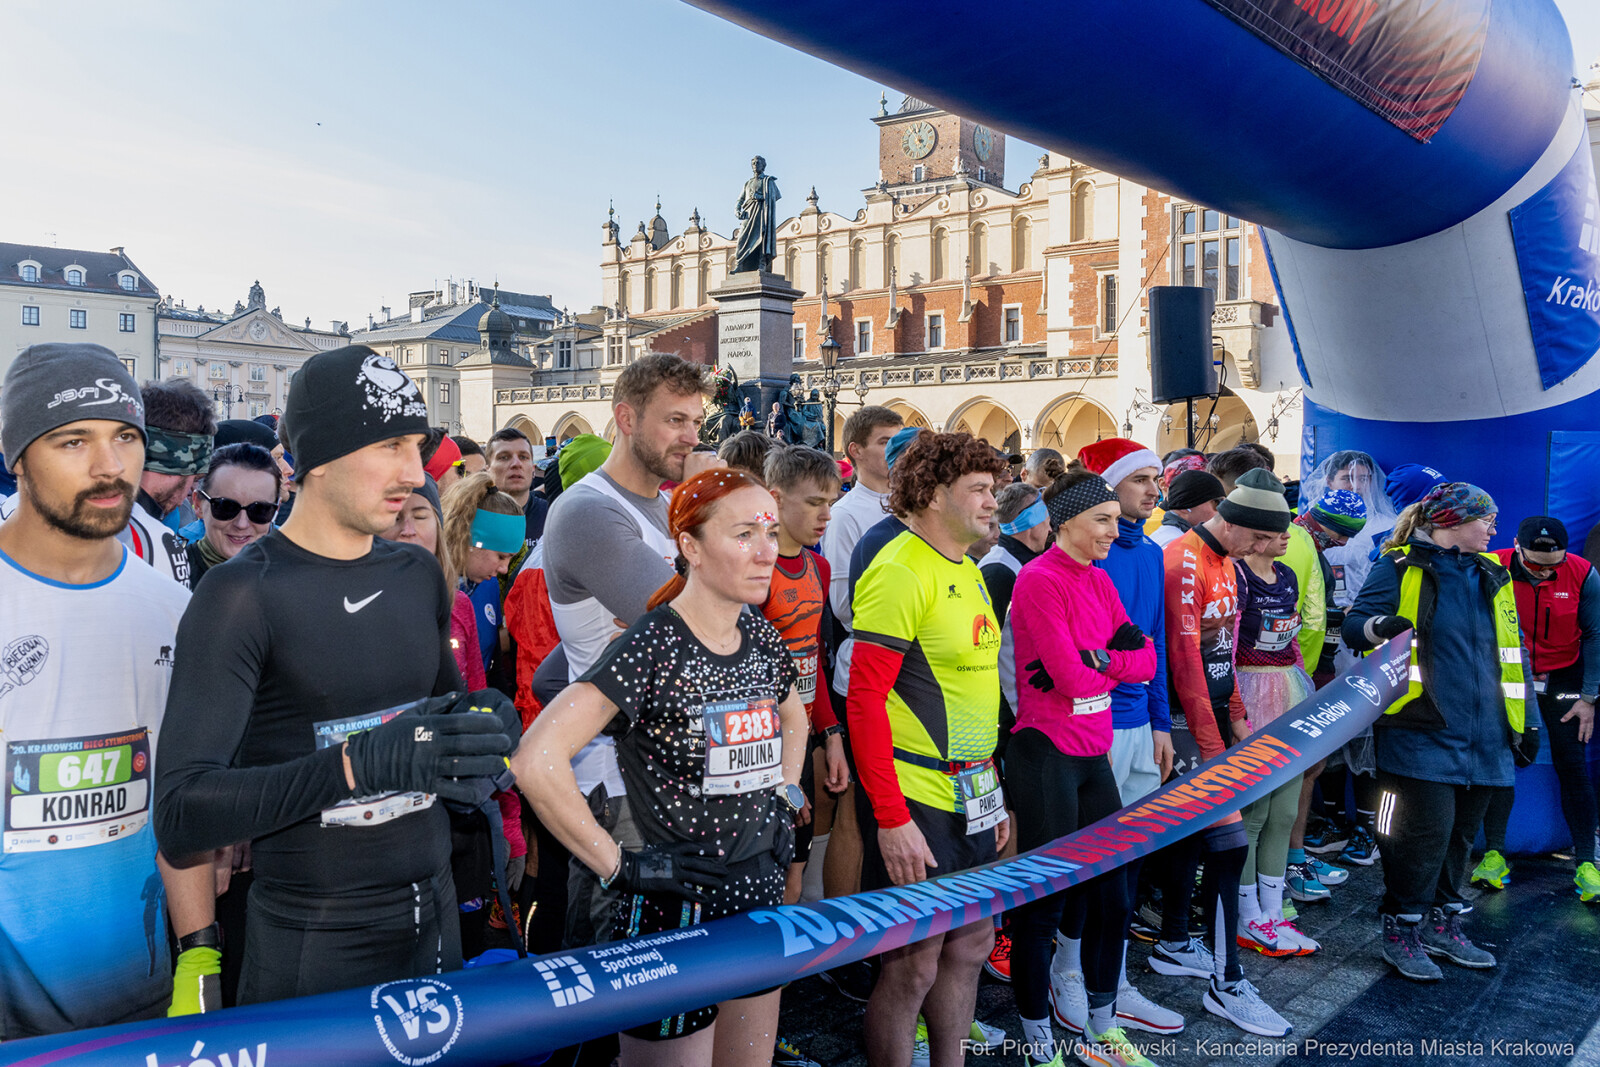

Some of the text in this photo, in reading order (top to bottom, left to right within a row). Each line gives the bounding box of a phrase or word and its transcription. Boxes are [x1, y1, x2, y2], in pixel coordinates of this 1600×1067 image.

[725, 323, 754, 331] ADAMOWI
[1181, 548, 1197, 605] KLIF
[7, 638, 40, 669] BIEGOWA
[17, 650, 44, 675] KUŹNIA
[1208, 661, 1231, 673] PRO
[333, 716, 382, 733] KRAKOWSKI
[728, 709, 773, 743] 2383
[1306, 700, 1352, 728] Kraków
[13, 745, 27, 755] 20.
[27, 741, 84, 754] KRAKOWSKI
[83, 739, 104, 750] BIEG
[728, 742, 774, 770] PAULINA
[57, 750, 121, 788] 647
[42, 787, 127, 822] KONRAD
[748, 904, 856, 958] 20.
[819, 854, 1084, 934] KRAKOWSKI
[1043, 826, 1148, 865] BIEG
[1117, 734, 1302, 833] SYLWESTROWY
[588, 927, 709, 959] Zarząd Infrastruktury
[600, 948, 664, 973] Sportowej
[610, 961, 679, 991] w Krakowie
[381, 985, 451, 1040] VS
[374, 994, 464, 1066] ORGANIZACJA IMPREZ SPORTOWYCH
